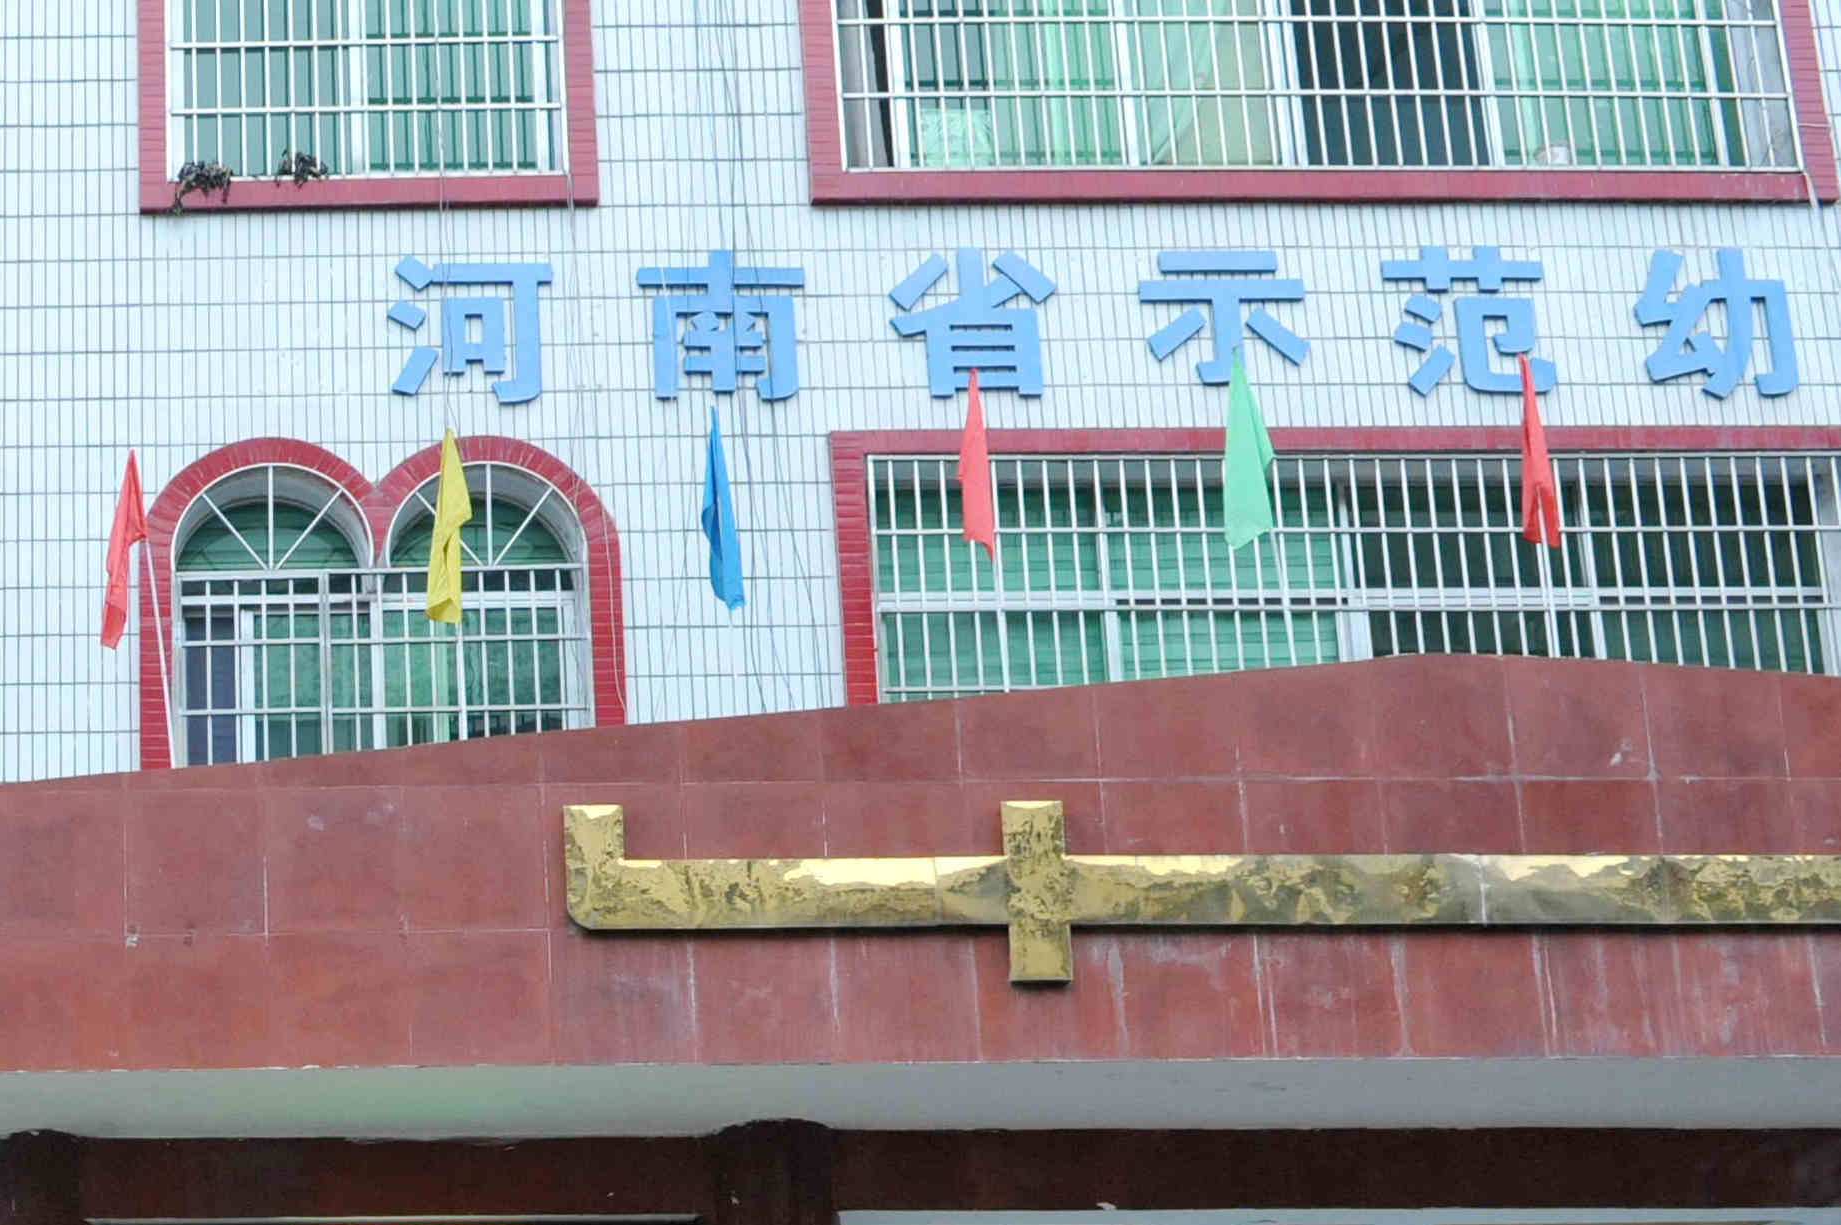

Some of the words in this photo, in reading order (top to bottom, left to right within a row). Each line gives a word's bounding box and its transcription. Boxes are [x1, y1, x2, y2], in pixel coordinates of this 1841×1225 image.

[387, 245, 1800, 403] 河南省示范幼
